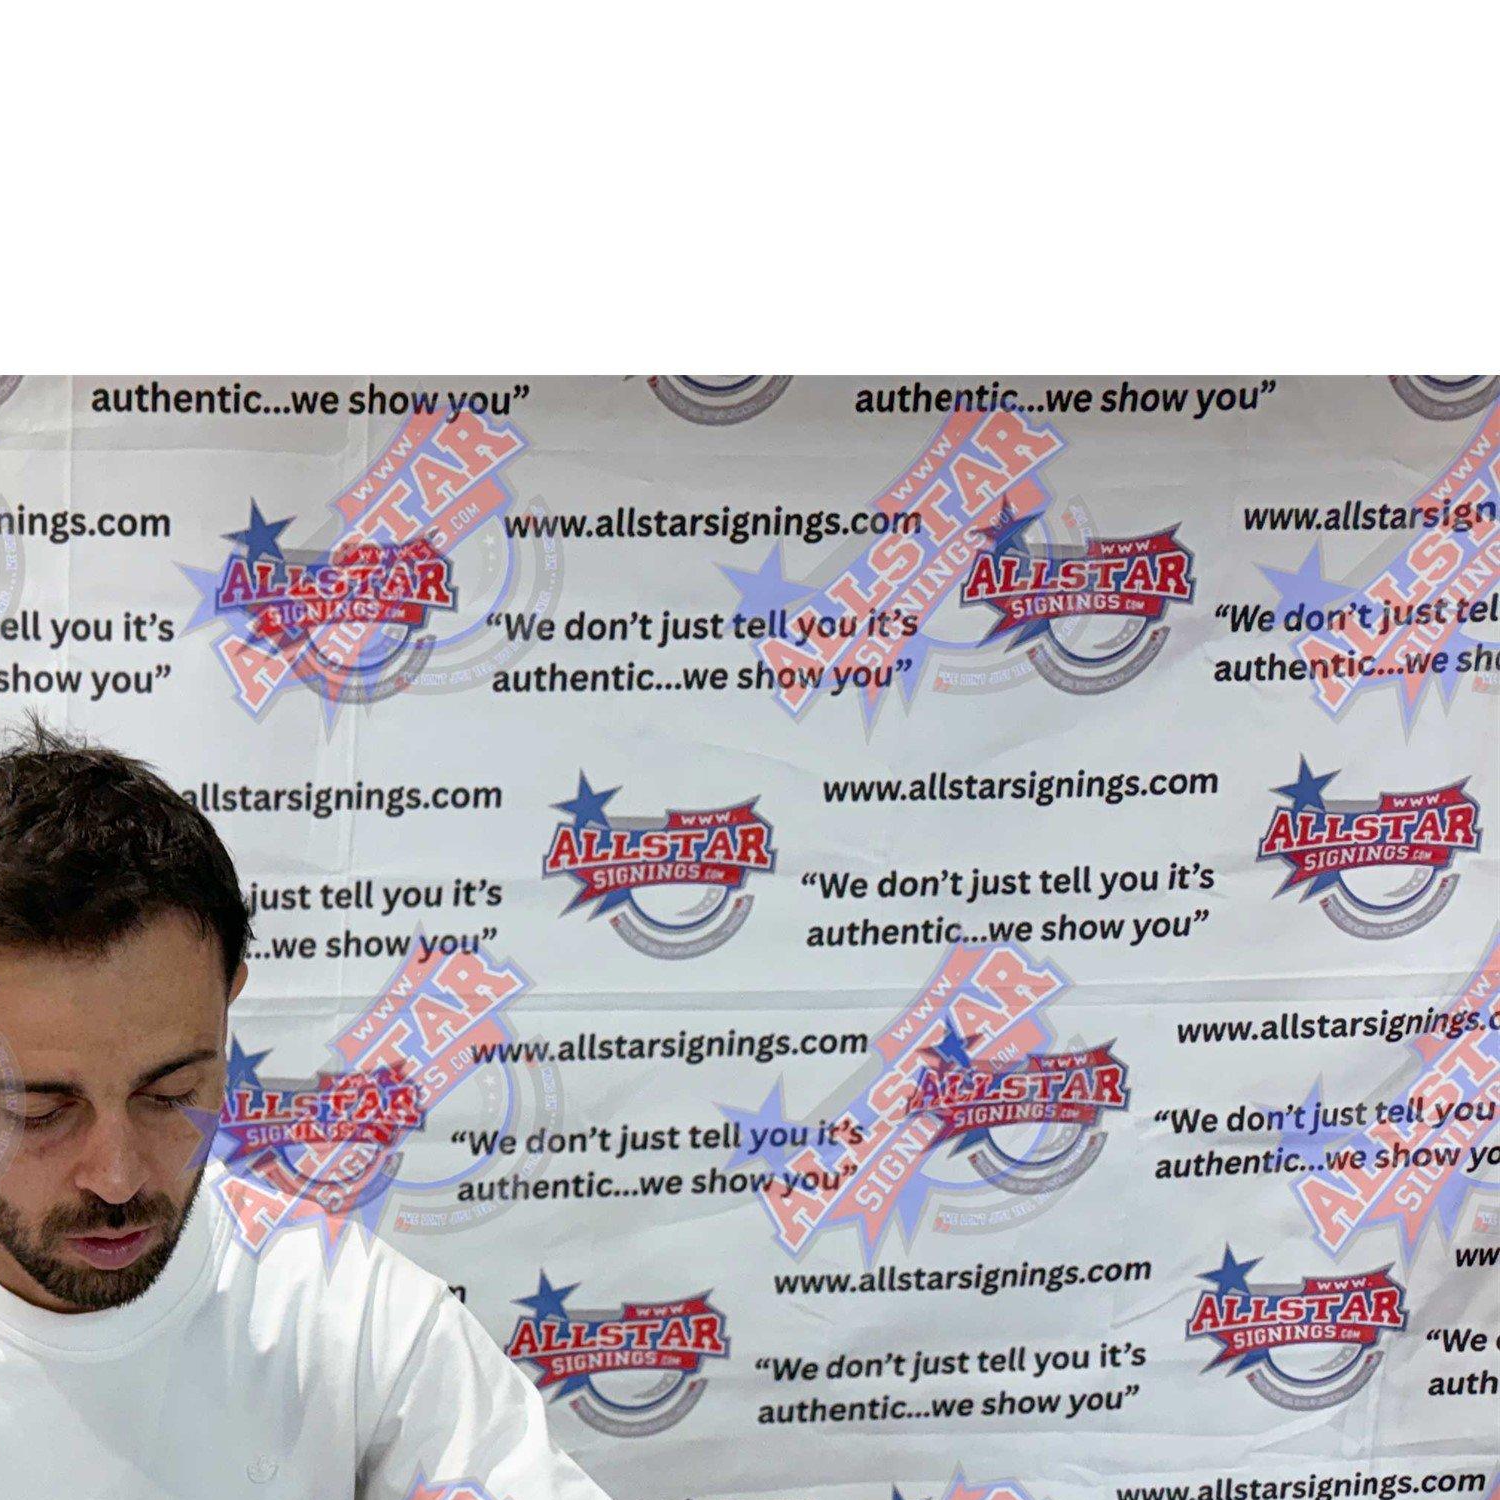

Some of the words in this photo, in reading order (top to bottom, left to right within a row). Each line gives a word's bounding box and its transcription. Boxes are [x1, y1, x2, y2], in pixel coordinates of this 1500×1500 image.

[348, 382, 439, 416] show
[1099, 380, 1190, 414] show
[504, 505, 922, 545] www.allstarsignings.com
[962, 552, 1193, 602] ALLSTAR
[657, 610, 724, 649] just
[732, 609, 787, 640] tell
[795, 616, 857, 647] you
[736, 660, 825, 690] show
[823, 769, 1219, 807] www.allstarsignings.com
[545, 822, 772, 873] ALLSTAR
[1261, 802, 1477, 856] ALLSTAR
[966, 868, 1031, 904] just
[1039, 865, 1092, 895] tell
[1098, 870, 1159, 900] you
[1040, 913, 1125, 942] show
[471, 1029, 868, 1065] www.allstarsignings.com
[615, 1124, 681, 1159] just
[688, 1122, 741, 1150] tell
[748, 1128, 807, 1154] you
[690, 1167, 774, 1194] show
[774, 1261, 1152, 1296] www.allstarsignings.com
[1187, 1286, 1404, 1336] ALLSTAR
[507, 1313, 727, 1359] ALLSTAR
[909, 1350, 970, 1383] just
[976, 1346, 1026, 1373] tell
[1033, 1350, 1090, 1378] you
[980, 1390, 1062, 1416] show
